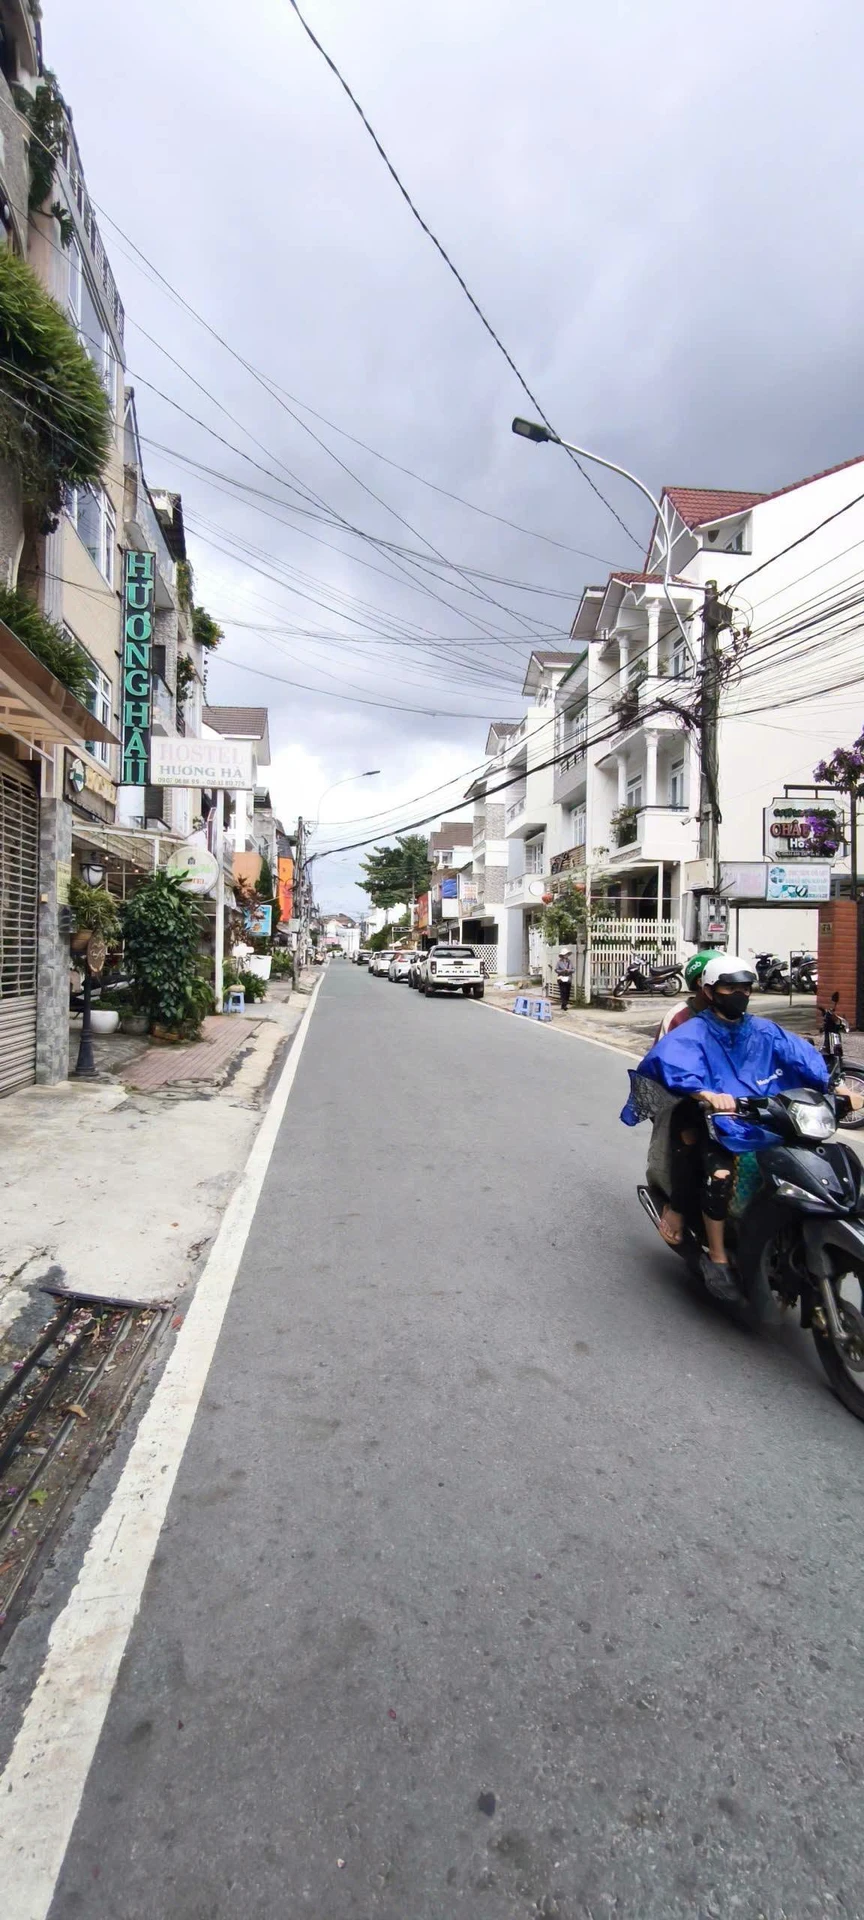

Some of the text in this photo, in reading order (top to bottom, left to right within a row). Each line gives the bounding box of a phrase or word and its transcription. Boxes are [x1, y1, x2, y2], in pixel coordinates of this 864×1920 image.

[157, 743, 243, 765] HOSTEL
[221, 766, 243, 778] HÀ
[686, 960, 702, 976] Grab
